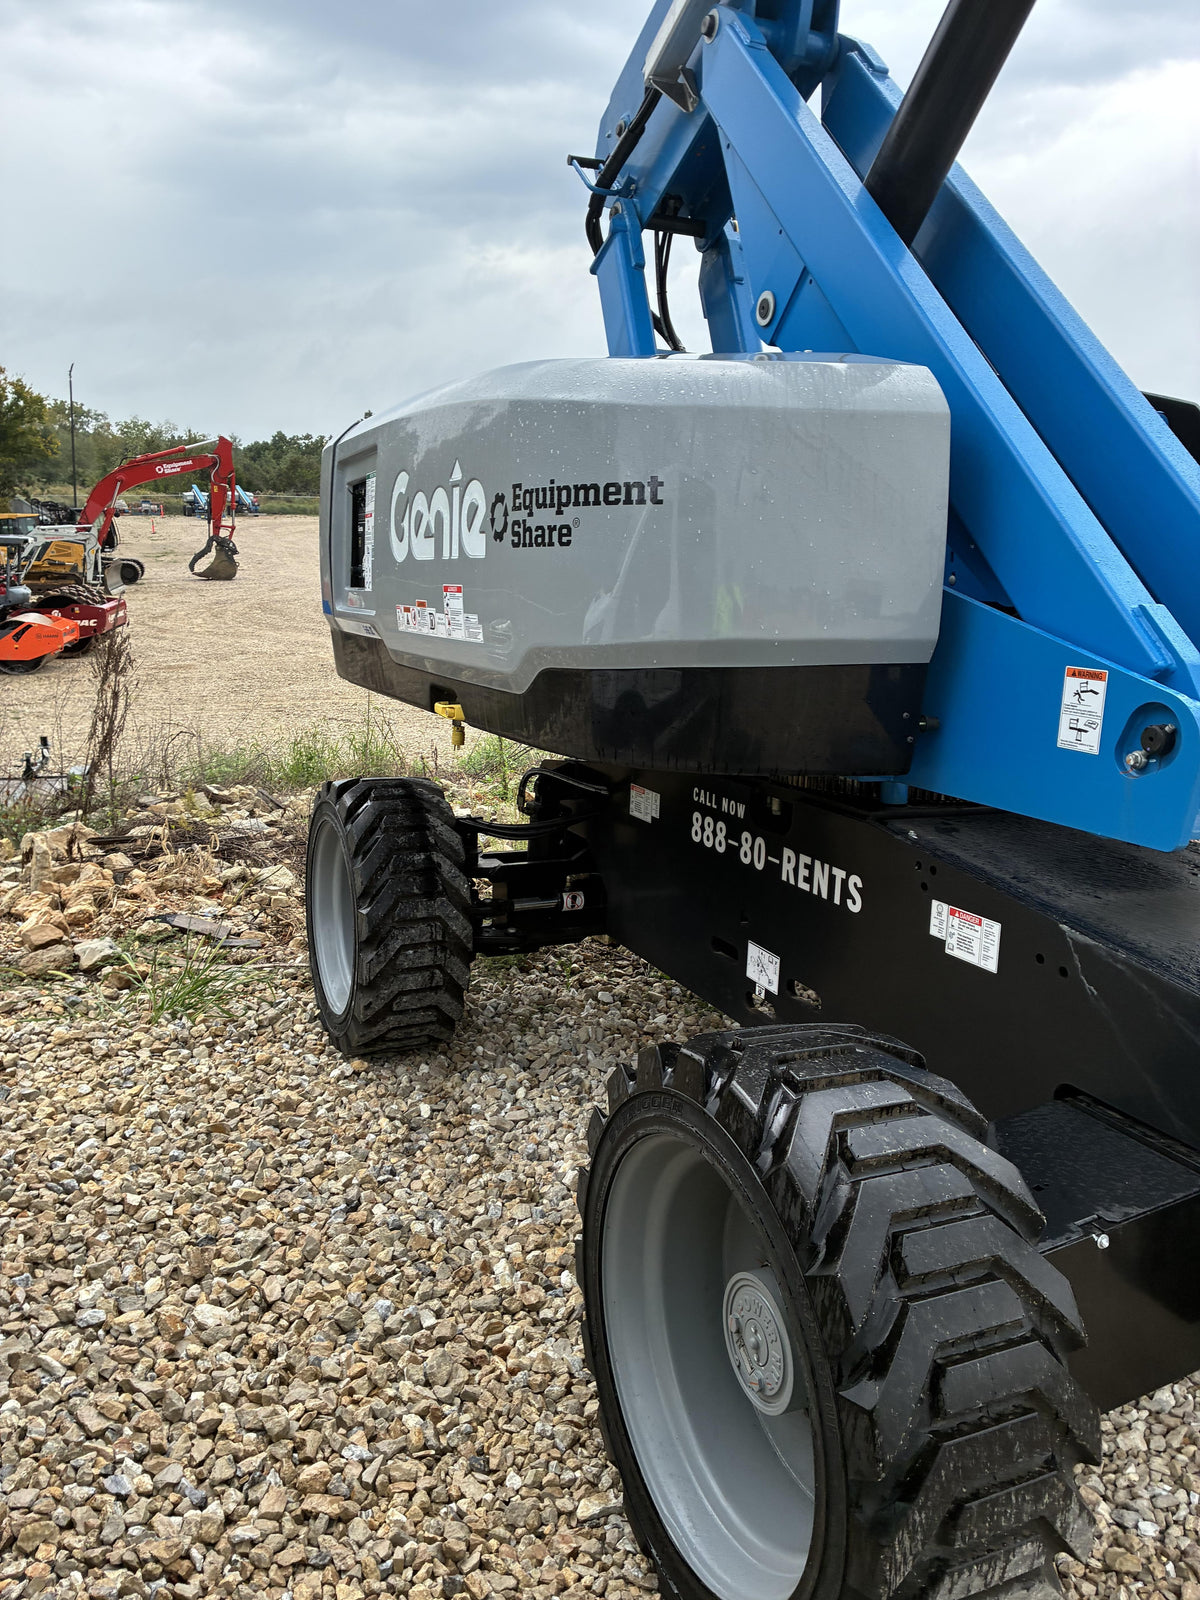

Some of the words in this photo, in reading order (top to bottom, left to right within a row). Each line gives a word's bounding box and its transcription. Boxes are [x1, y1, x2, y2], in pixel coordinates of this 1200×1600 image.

[390, 458, 486, 563] Genie
[511, 475, 665, 517] Equipment
[1078, 670, 1103, 681] WARNING
[693, 787, 717, 809] CALL
[721, 796, 746, 819] NOW
[691, 811, 863, 914] 888-80-RENTS
[959, 911, 980, 925] DANGER
